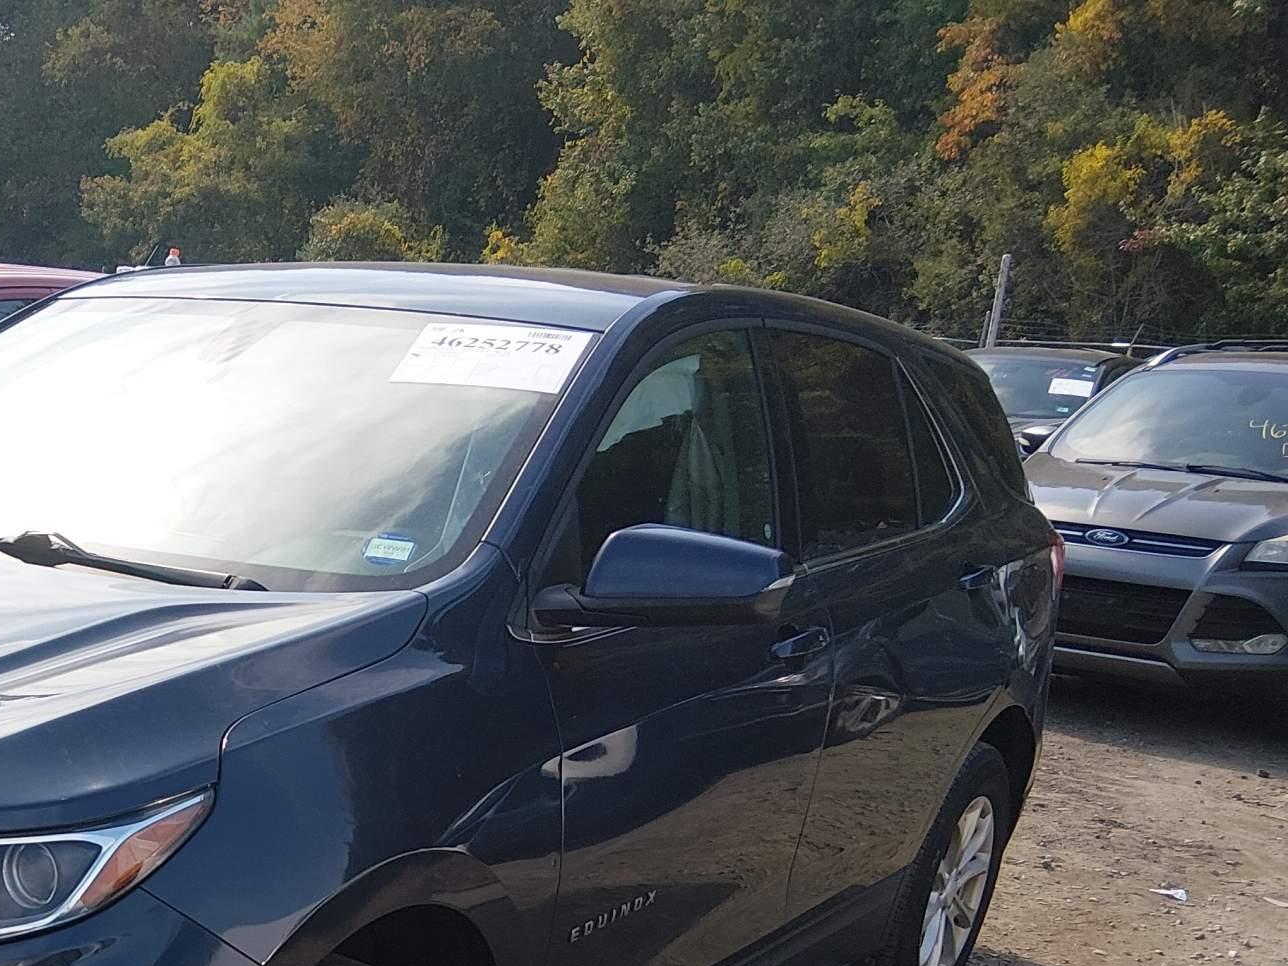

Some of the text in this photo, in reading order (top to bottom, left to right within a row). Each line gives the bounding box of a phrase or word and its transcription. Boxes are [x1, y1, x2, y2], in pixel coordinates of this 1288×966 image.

[431, 336, 564, 355] 46252778
[1249, 419, 1288, 439] 46
[1093, 531, 1119, 543] Ford
[570, 889, 657, 943] EQUINOX
